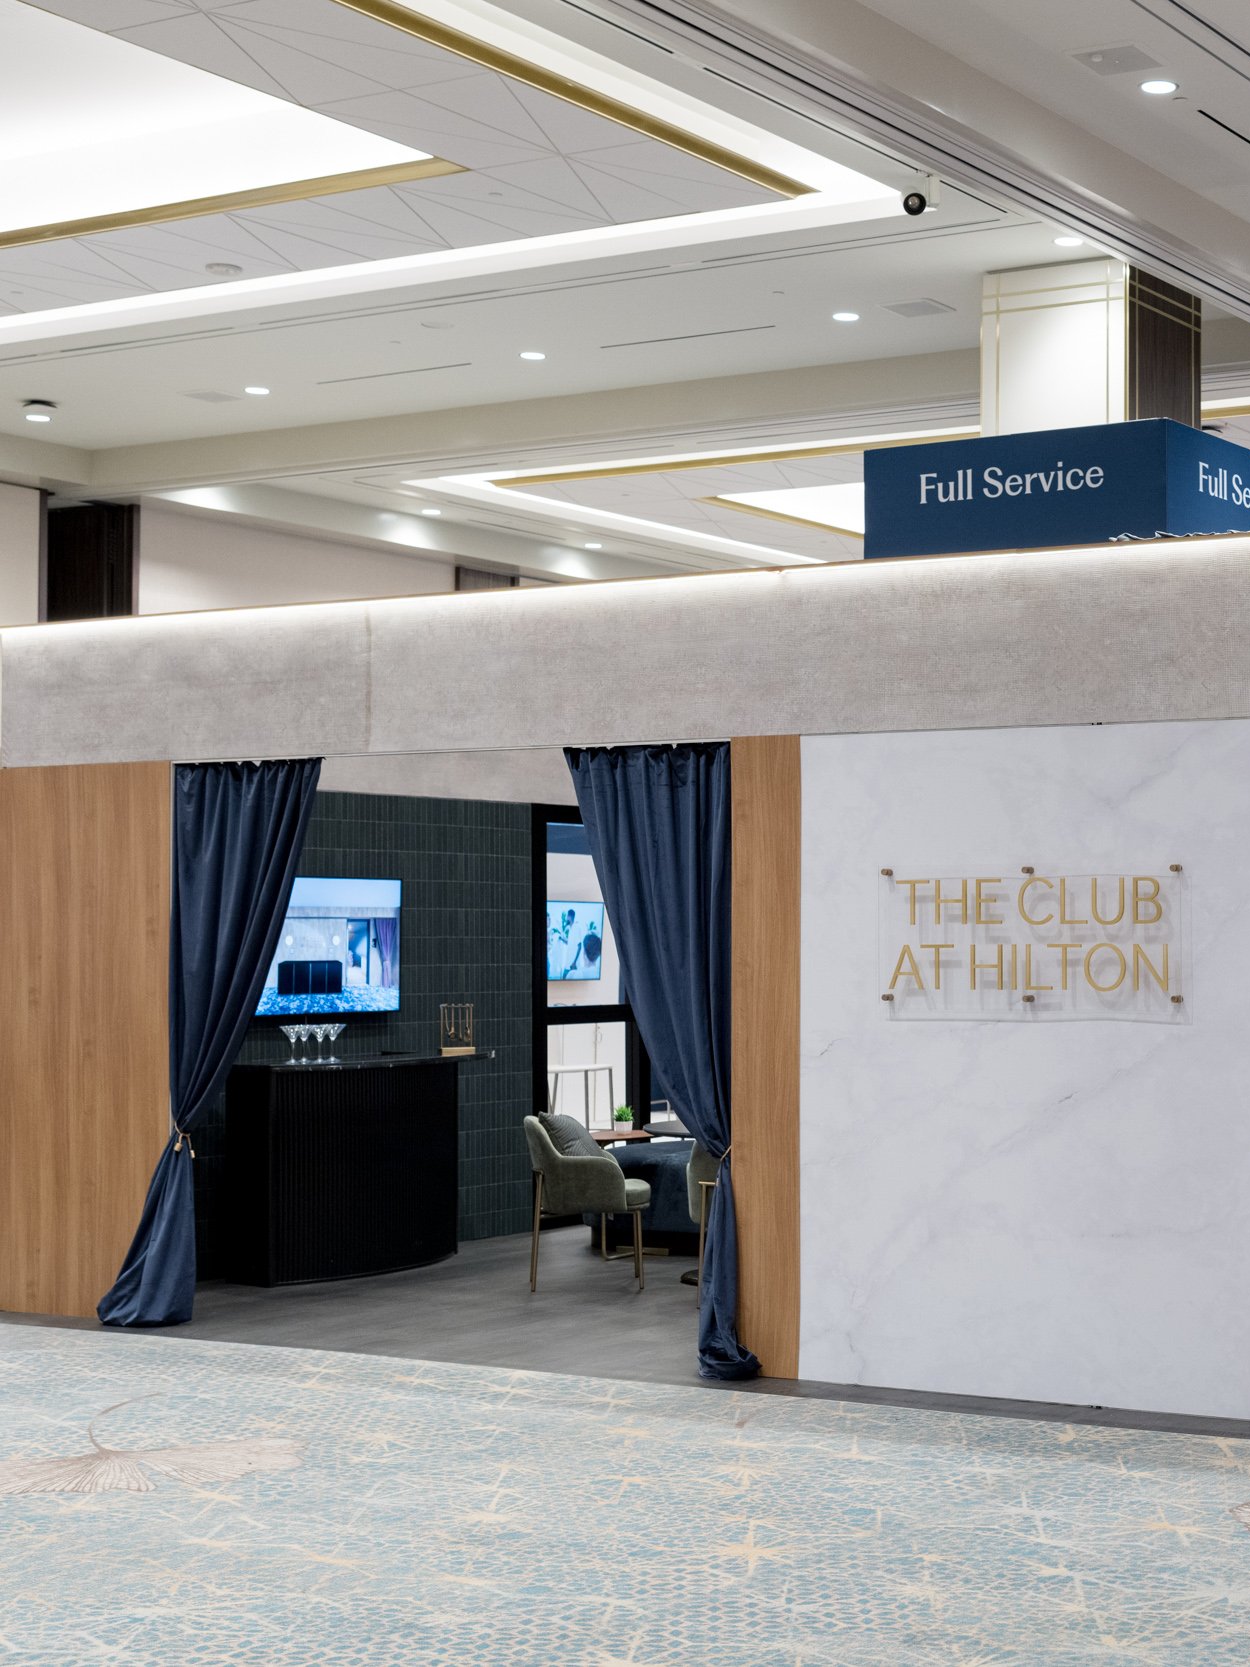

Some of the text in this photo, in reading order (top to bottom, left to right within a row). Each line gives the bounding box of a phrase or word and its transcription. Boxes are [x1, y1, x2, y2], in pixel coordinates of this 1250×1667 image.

[919, 461, 1105, 505] Full Service
[1198, 461, 1228, 501] Full
[895, 876, 1163, 926] THE CLUB
[888, 942, 1169, 992] AT HILTON
